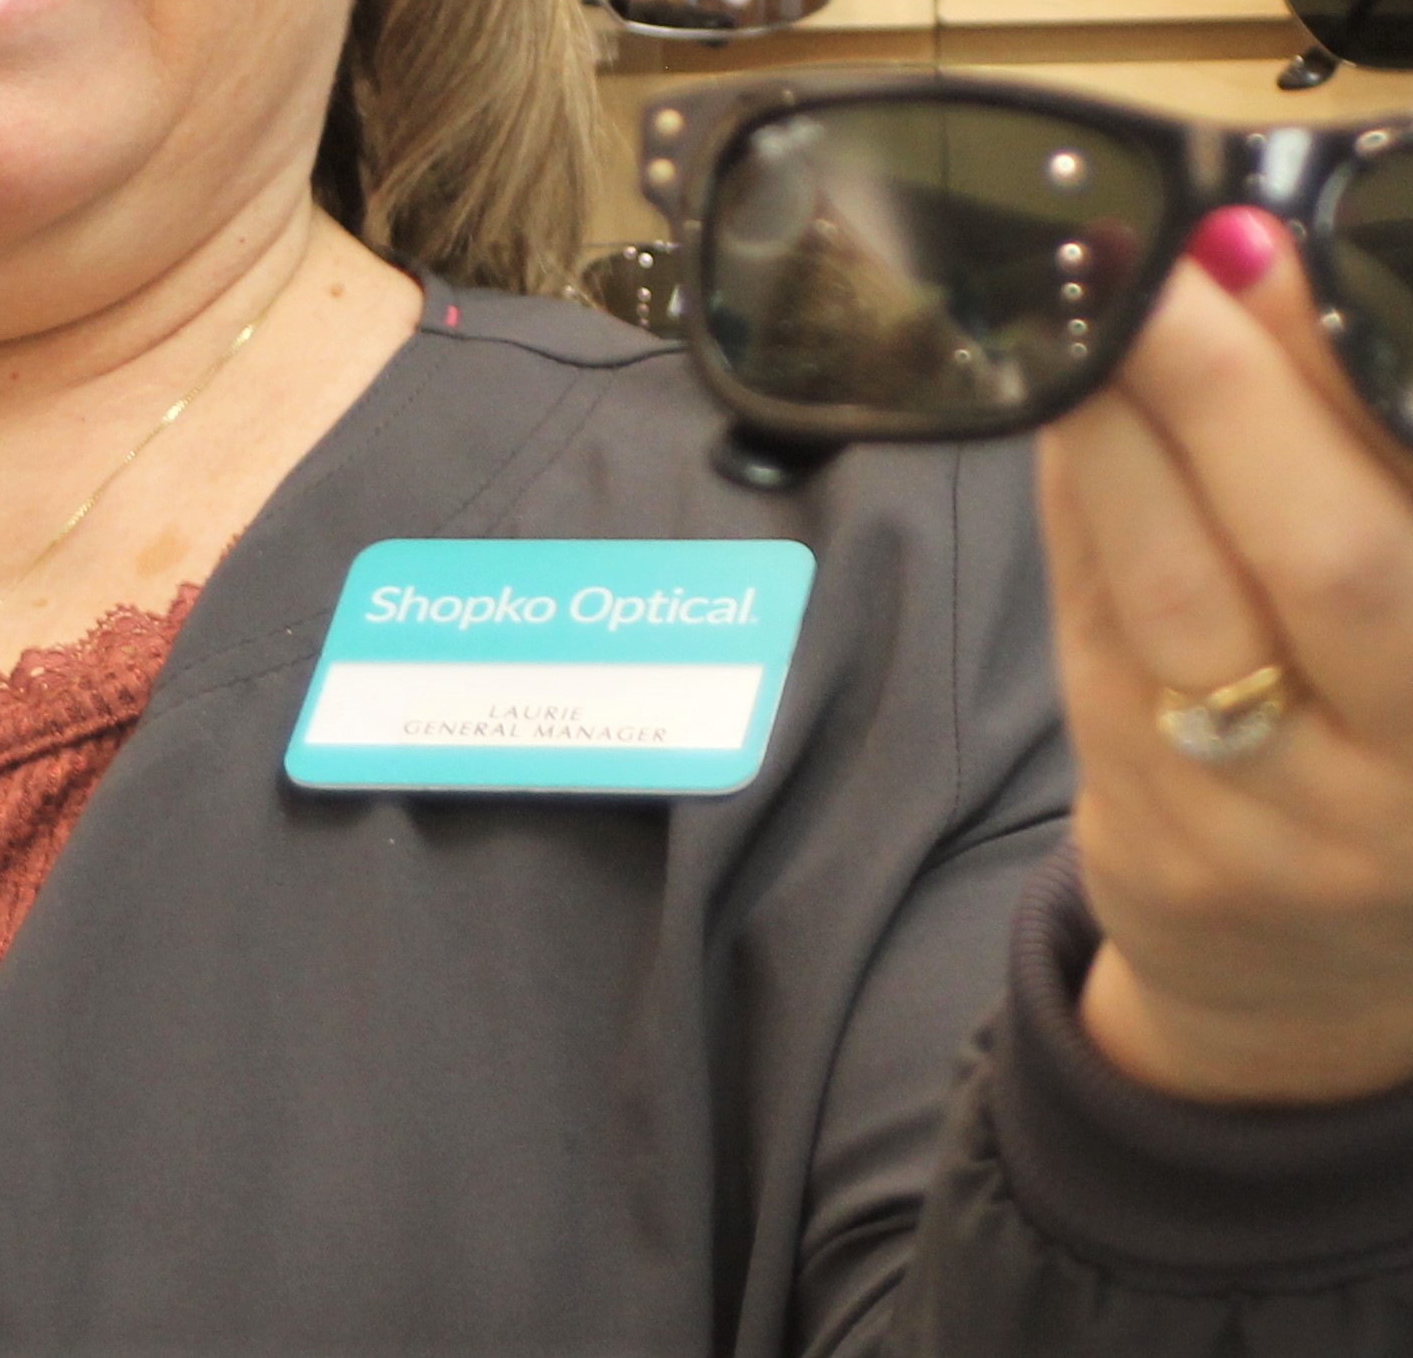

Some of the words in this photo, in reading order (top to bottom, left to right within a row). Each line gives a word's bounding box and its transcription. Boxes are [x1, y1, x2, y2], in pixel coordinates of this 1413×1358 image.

[364, 586, 556, 631] Shopko
[569, 586, 756, 632] Optical
[488, 704, 583, 721] LAURIE
[403, 721, 521, 737] GENERAL
[532, 725, 668, 742] MANAGER
